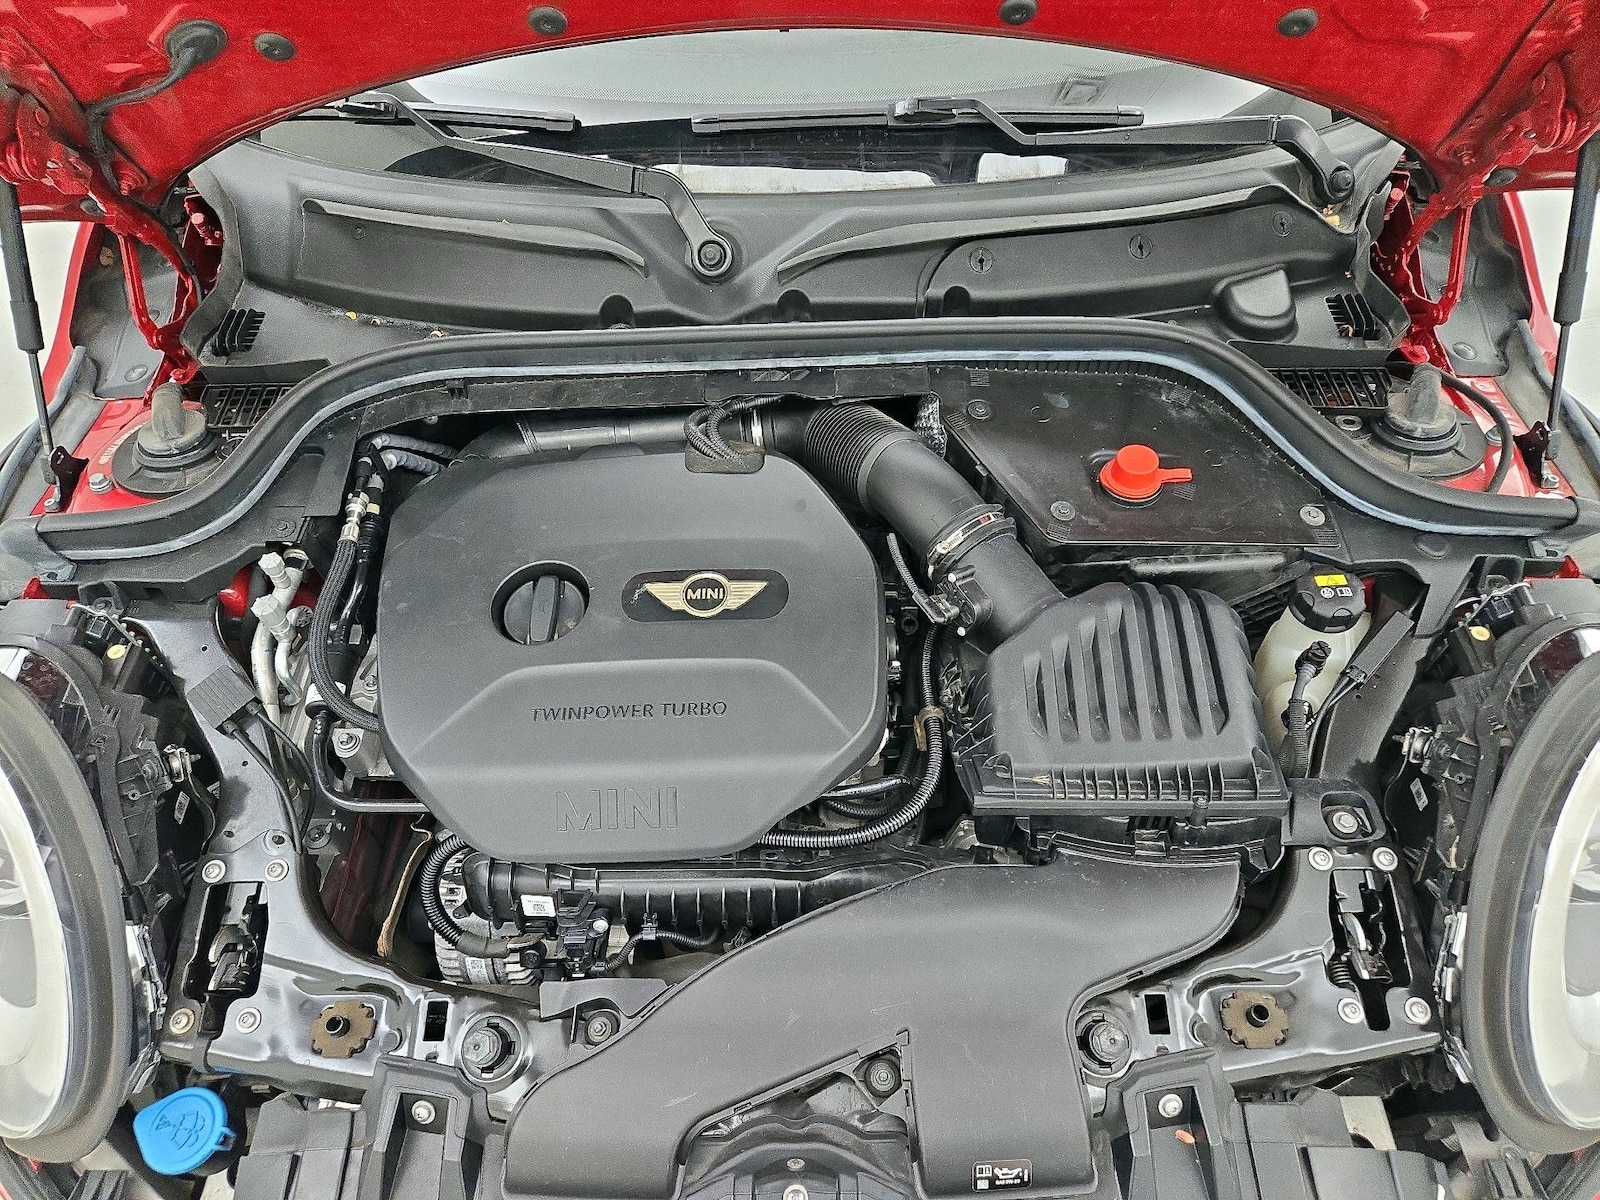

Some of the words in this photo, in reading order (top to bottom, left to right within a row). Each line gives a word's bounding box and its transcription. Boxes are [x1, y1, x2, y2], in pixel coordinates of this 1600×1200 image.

[686, 588, 725, 601] MINI
[532, 702, 654, 722] TWINPOWER
[661, 701, 727, 717] TURBO
[555, 787, 679, 831] MINI
